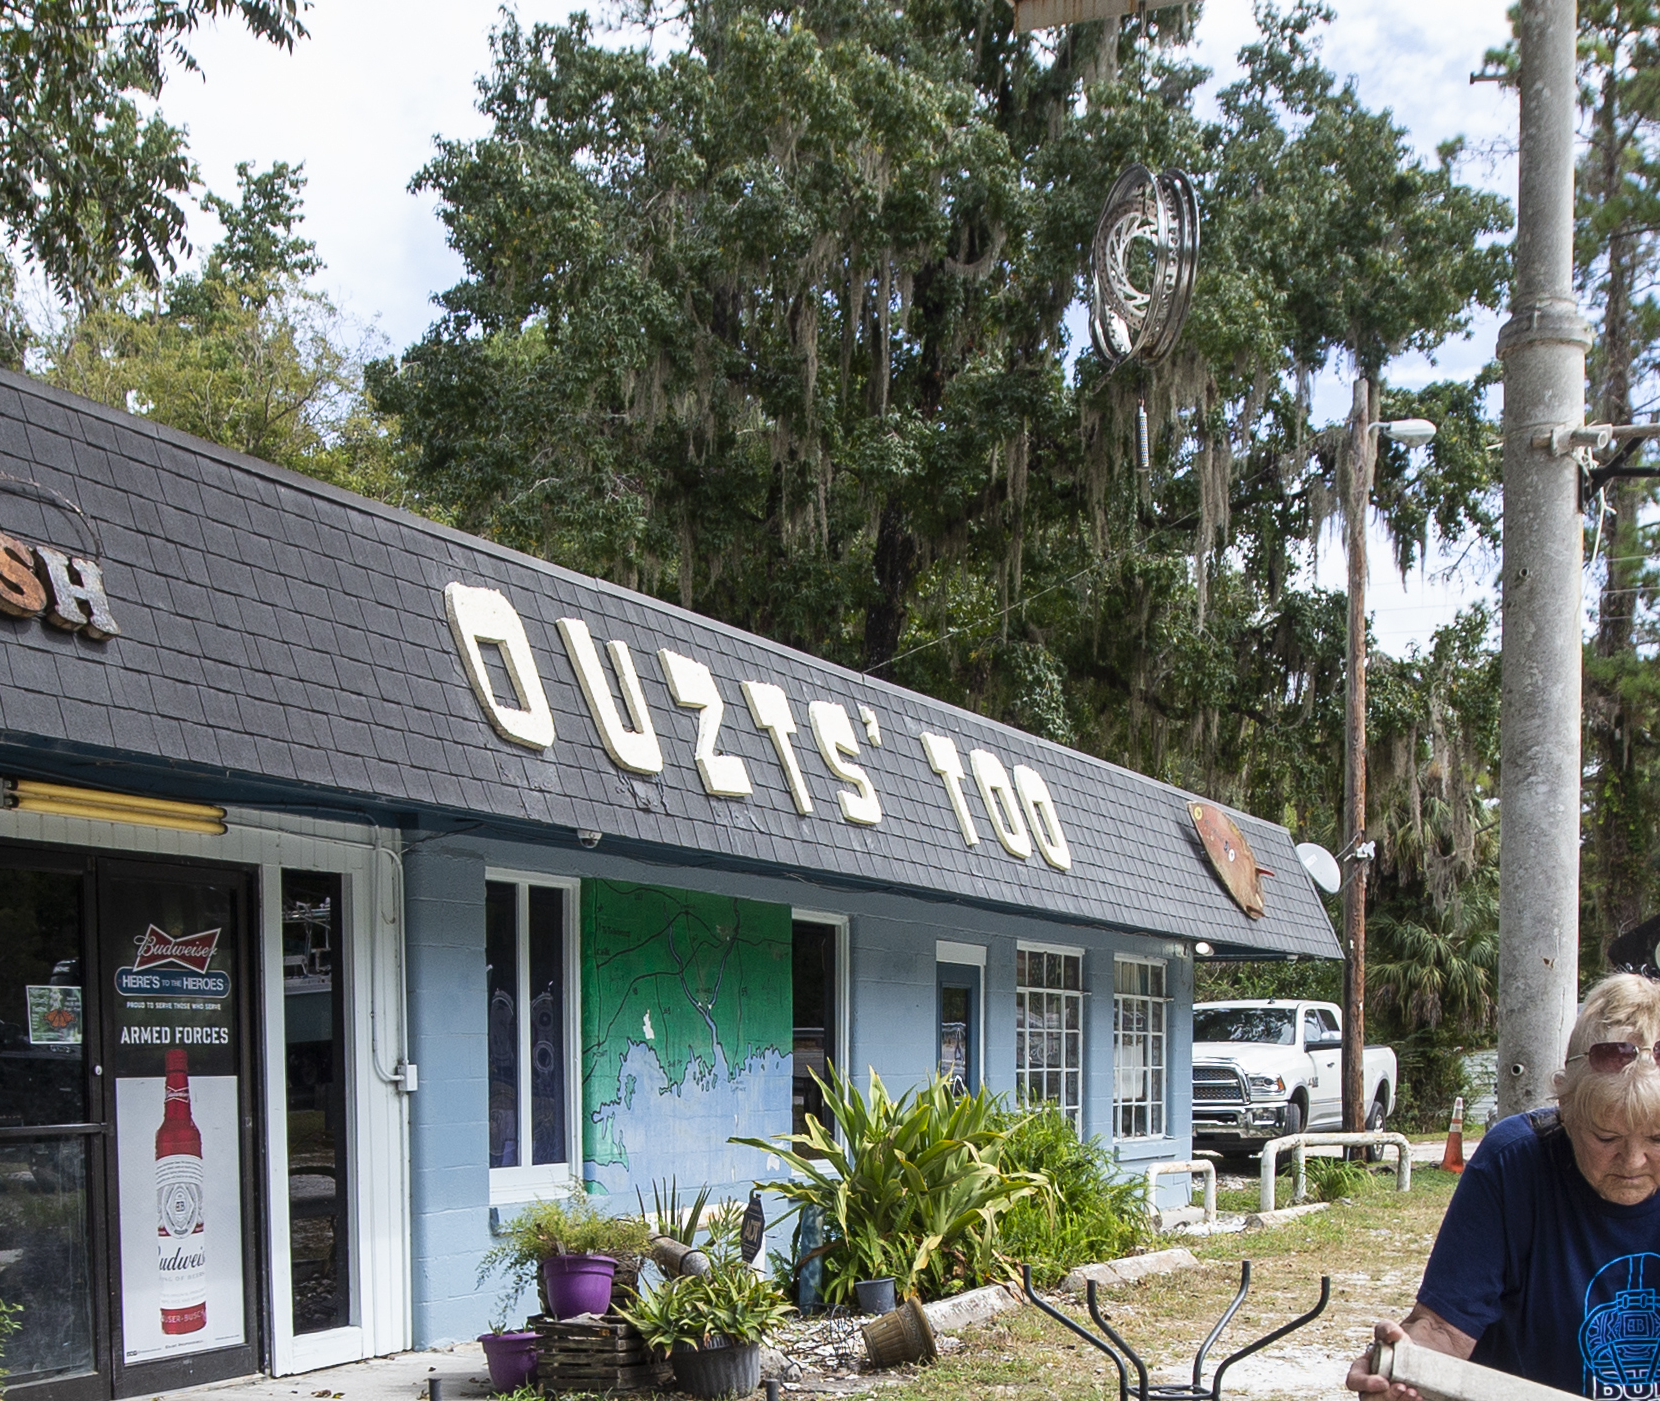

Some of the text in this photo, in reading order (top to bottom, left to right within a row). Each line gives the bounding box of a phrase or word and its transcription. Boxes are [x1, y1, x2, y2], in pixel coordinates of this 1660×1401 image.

[919, 731, 1073, 872] TOO
[133, 935, 218, 958] Budweiser
[122, 975, 160, 989] HERE'S
[171, 980, 182, 988] THE
[183, 977, 224, 991] HEROES
[126, 1001, 145, 1009] PROUD
[205, 1003, 221, 1011] SERVE
[121, 1026, 228, 1044] ARMED FORCES
